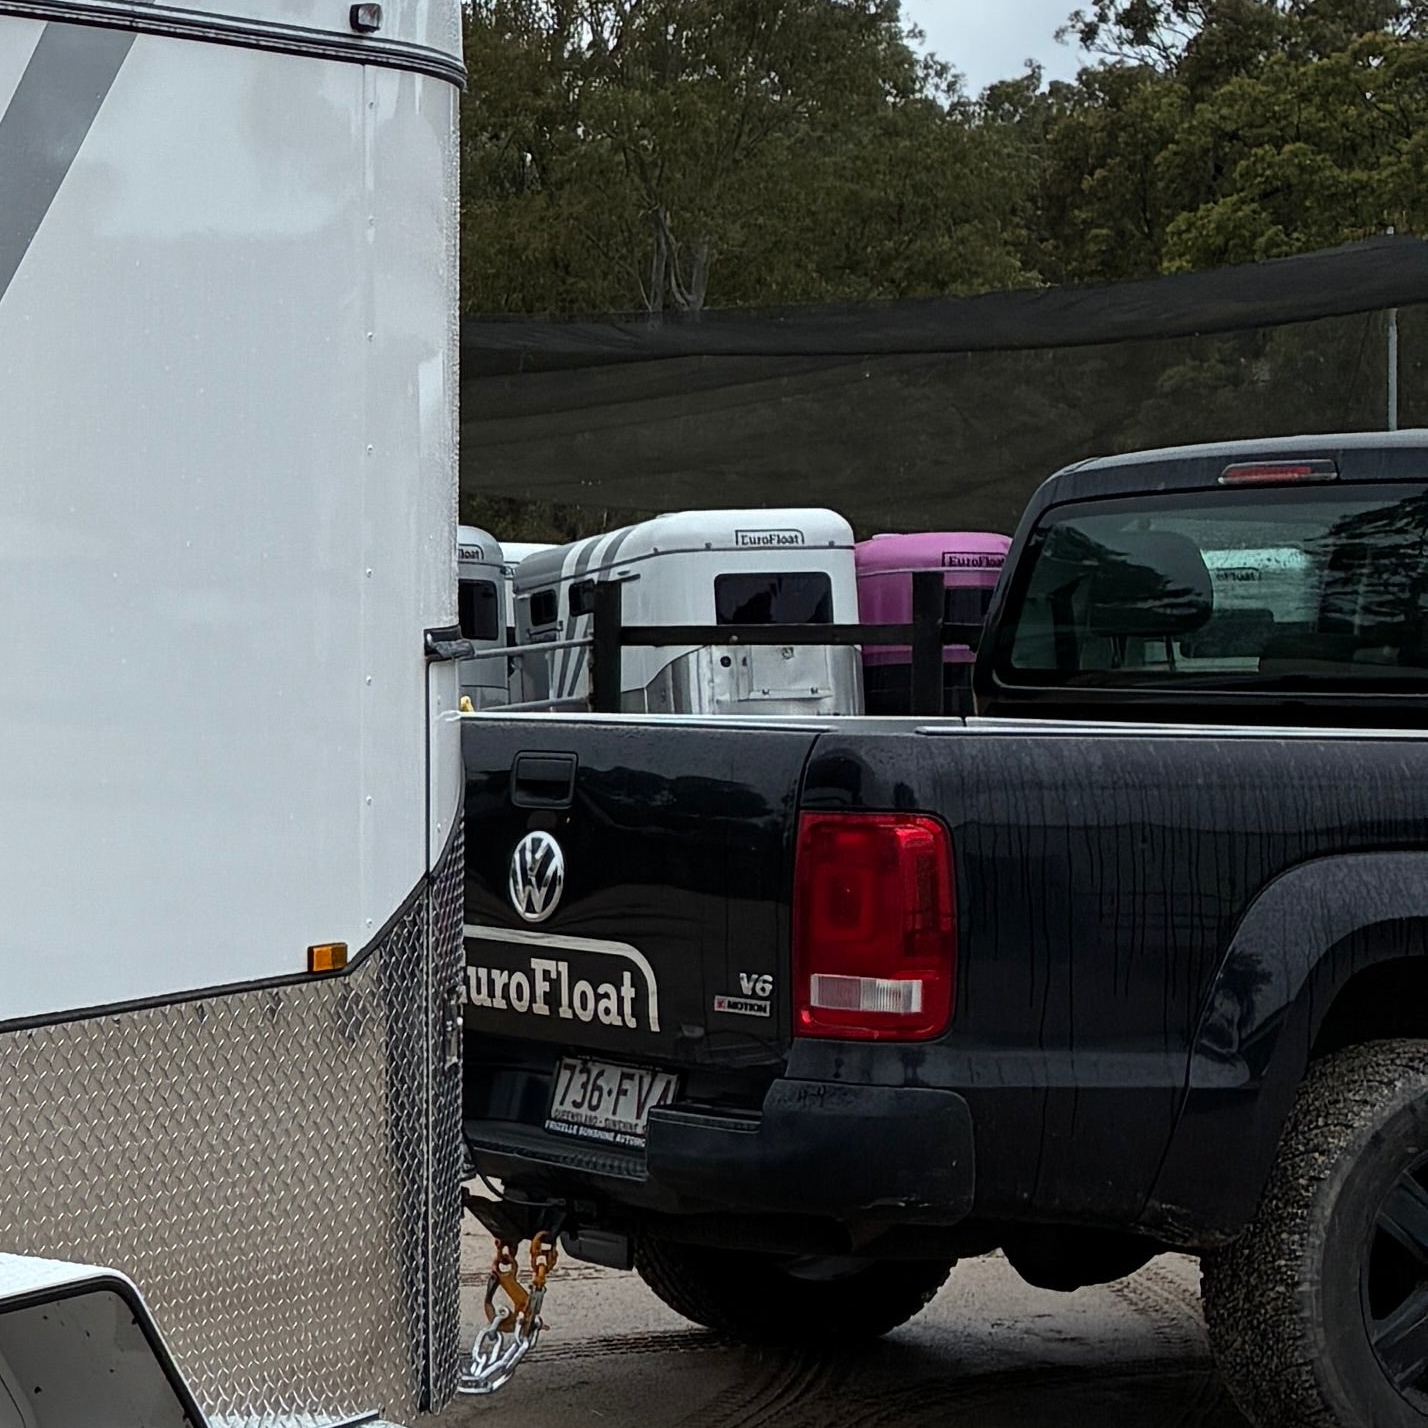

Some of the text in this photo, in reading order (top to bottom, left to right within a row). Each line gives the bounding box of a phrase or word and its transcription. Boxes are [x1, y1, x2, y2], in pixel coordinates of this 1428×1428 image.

[741, 534, 799, 545] EuroFloat
[459, 957, 637, 1029] uroFloat
[739, 972, 773, 997] V6
